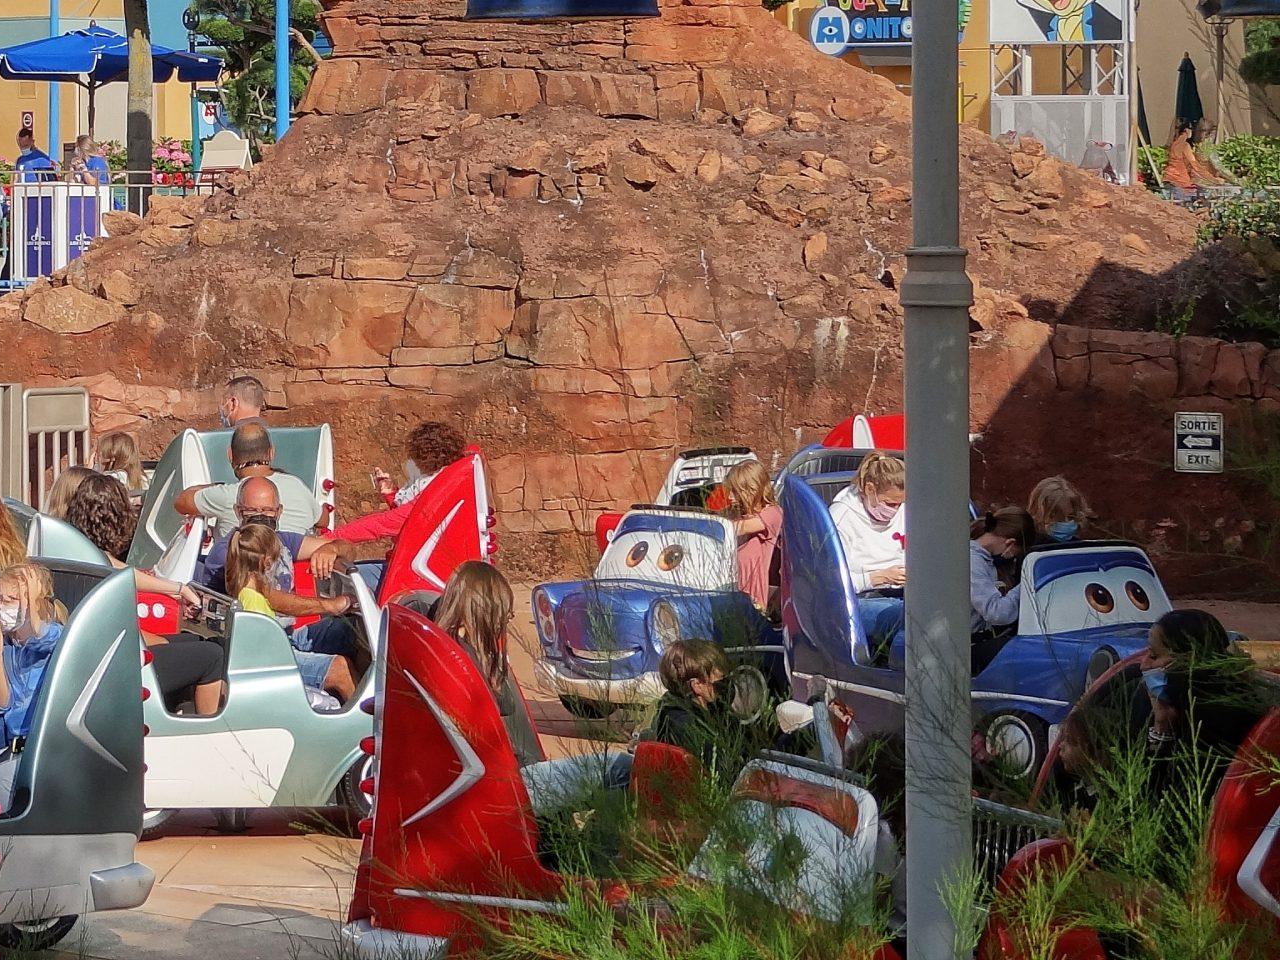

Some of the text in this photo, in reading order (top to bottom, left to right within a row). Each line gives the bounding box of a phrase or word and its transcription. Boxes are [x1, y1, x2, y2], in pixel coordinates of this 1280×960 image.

[815, 16, 913, 44] MONITO
[1180, 420, 1218, 431] SORTIE
[1187, 454, 1211, 465] EXIT
